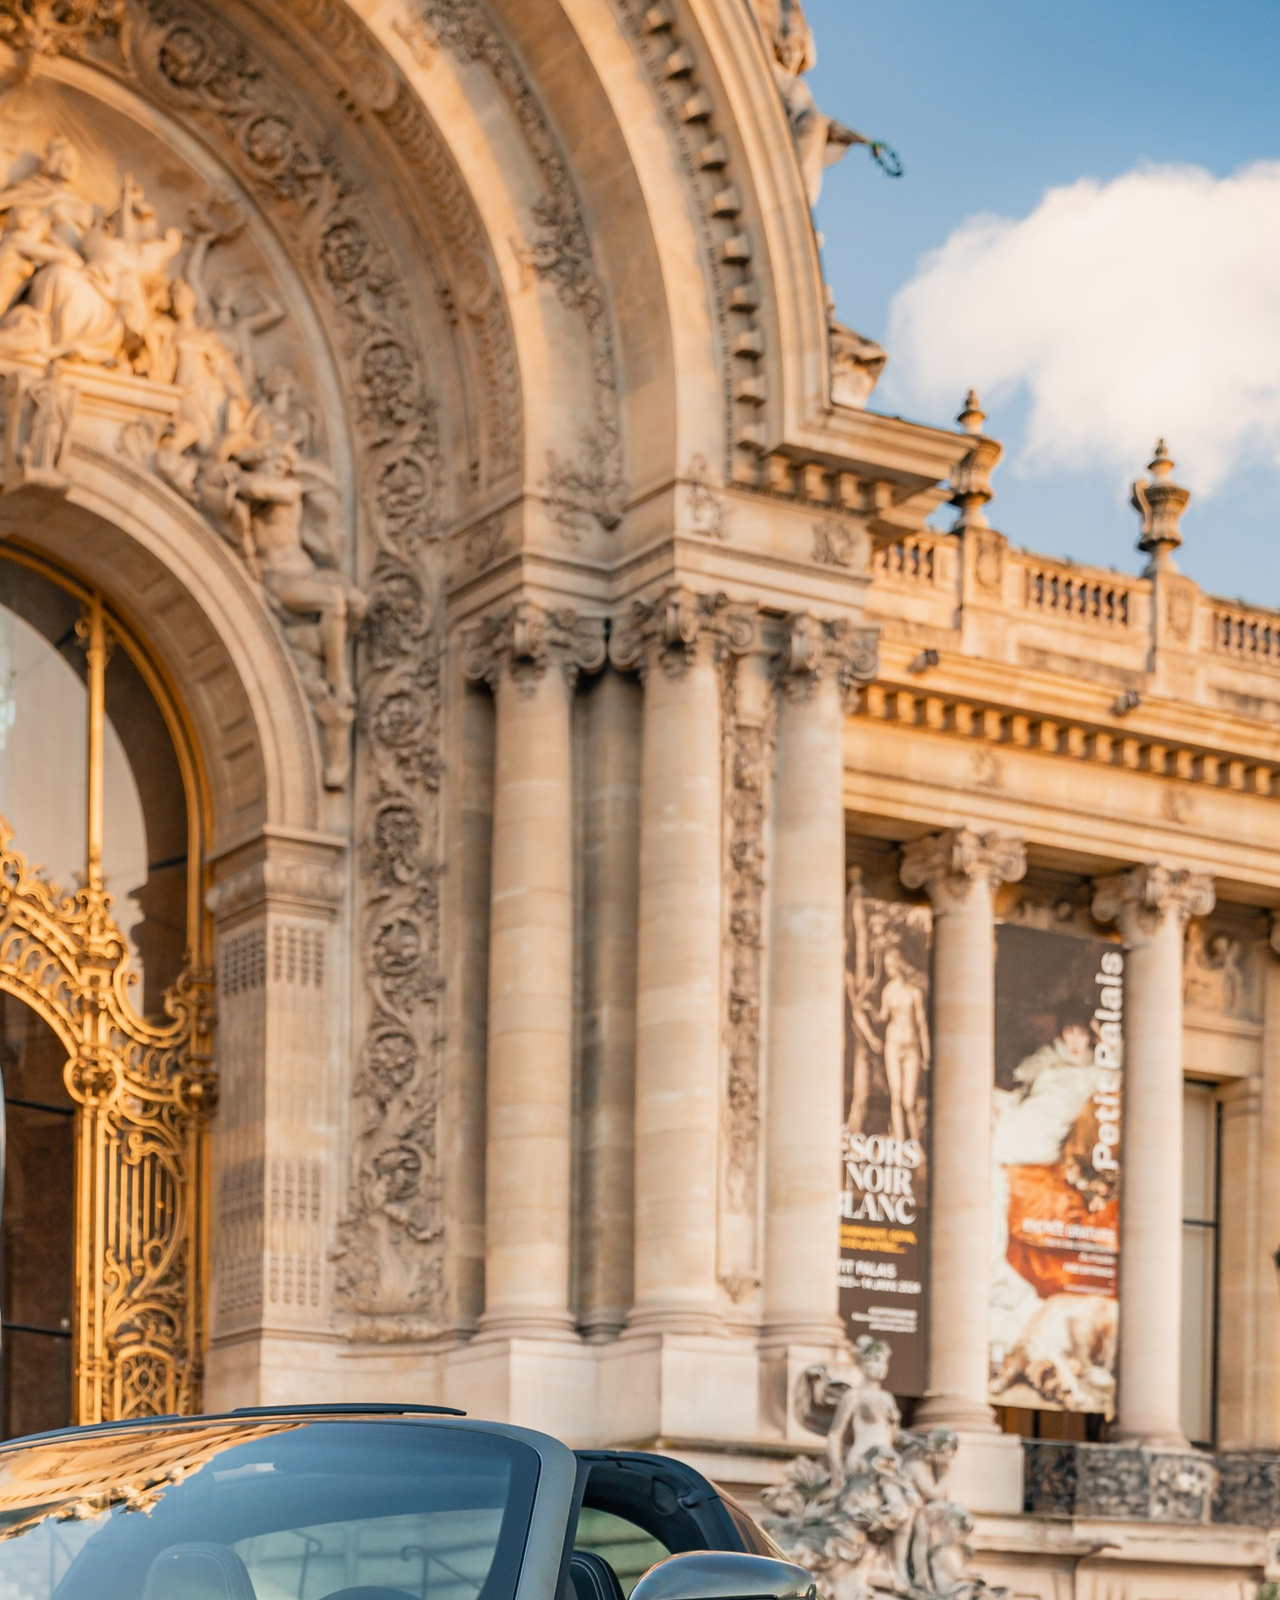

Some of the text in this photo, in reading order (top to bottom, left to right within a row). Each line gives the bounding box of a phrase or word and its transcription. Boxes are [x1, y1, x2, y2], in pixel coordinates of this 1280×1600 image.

[1092, 951, 1123, 1170] Petit Palais
[846, 1161, 913, 1198] NOIR
